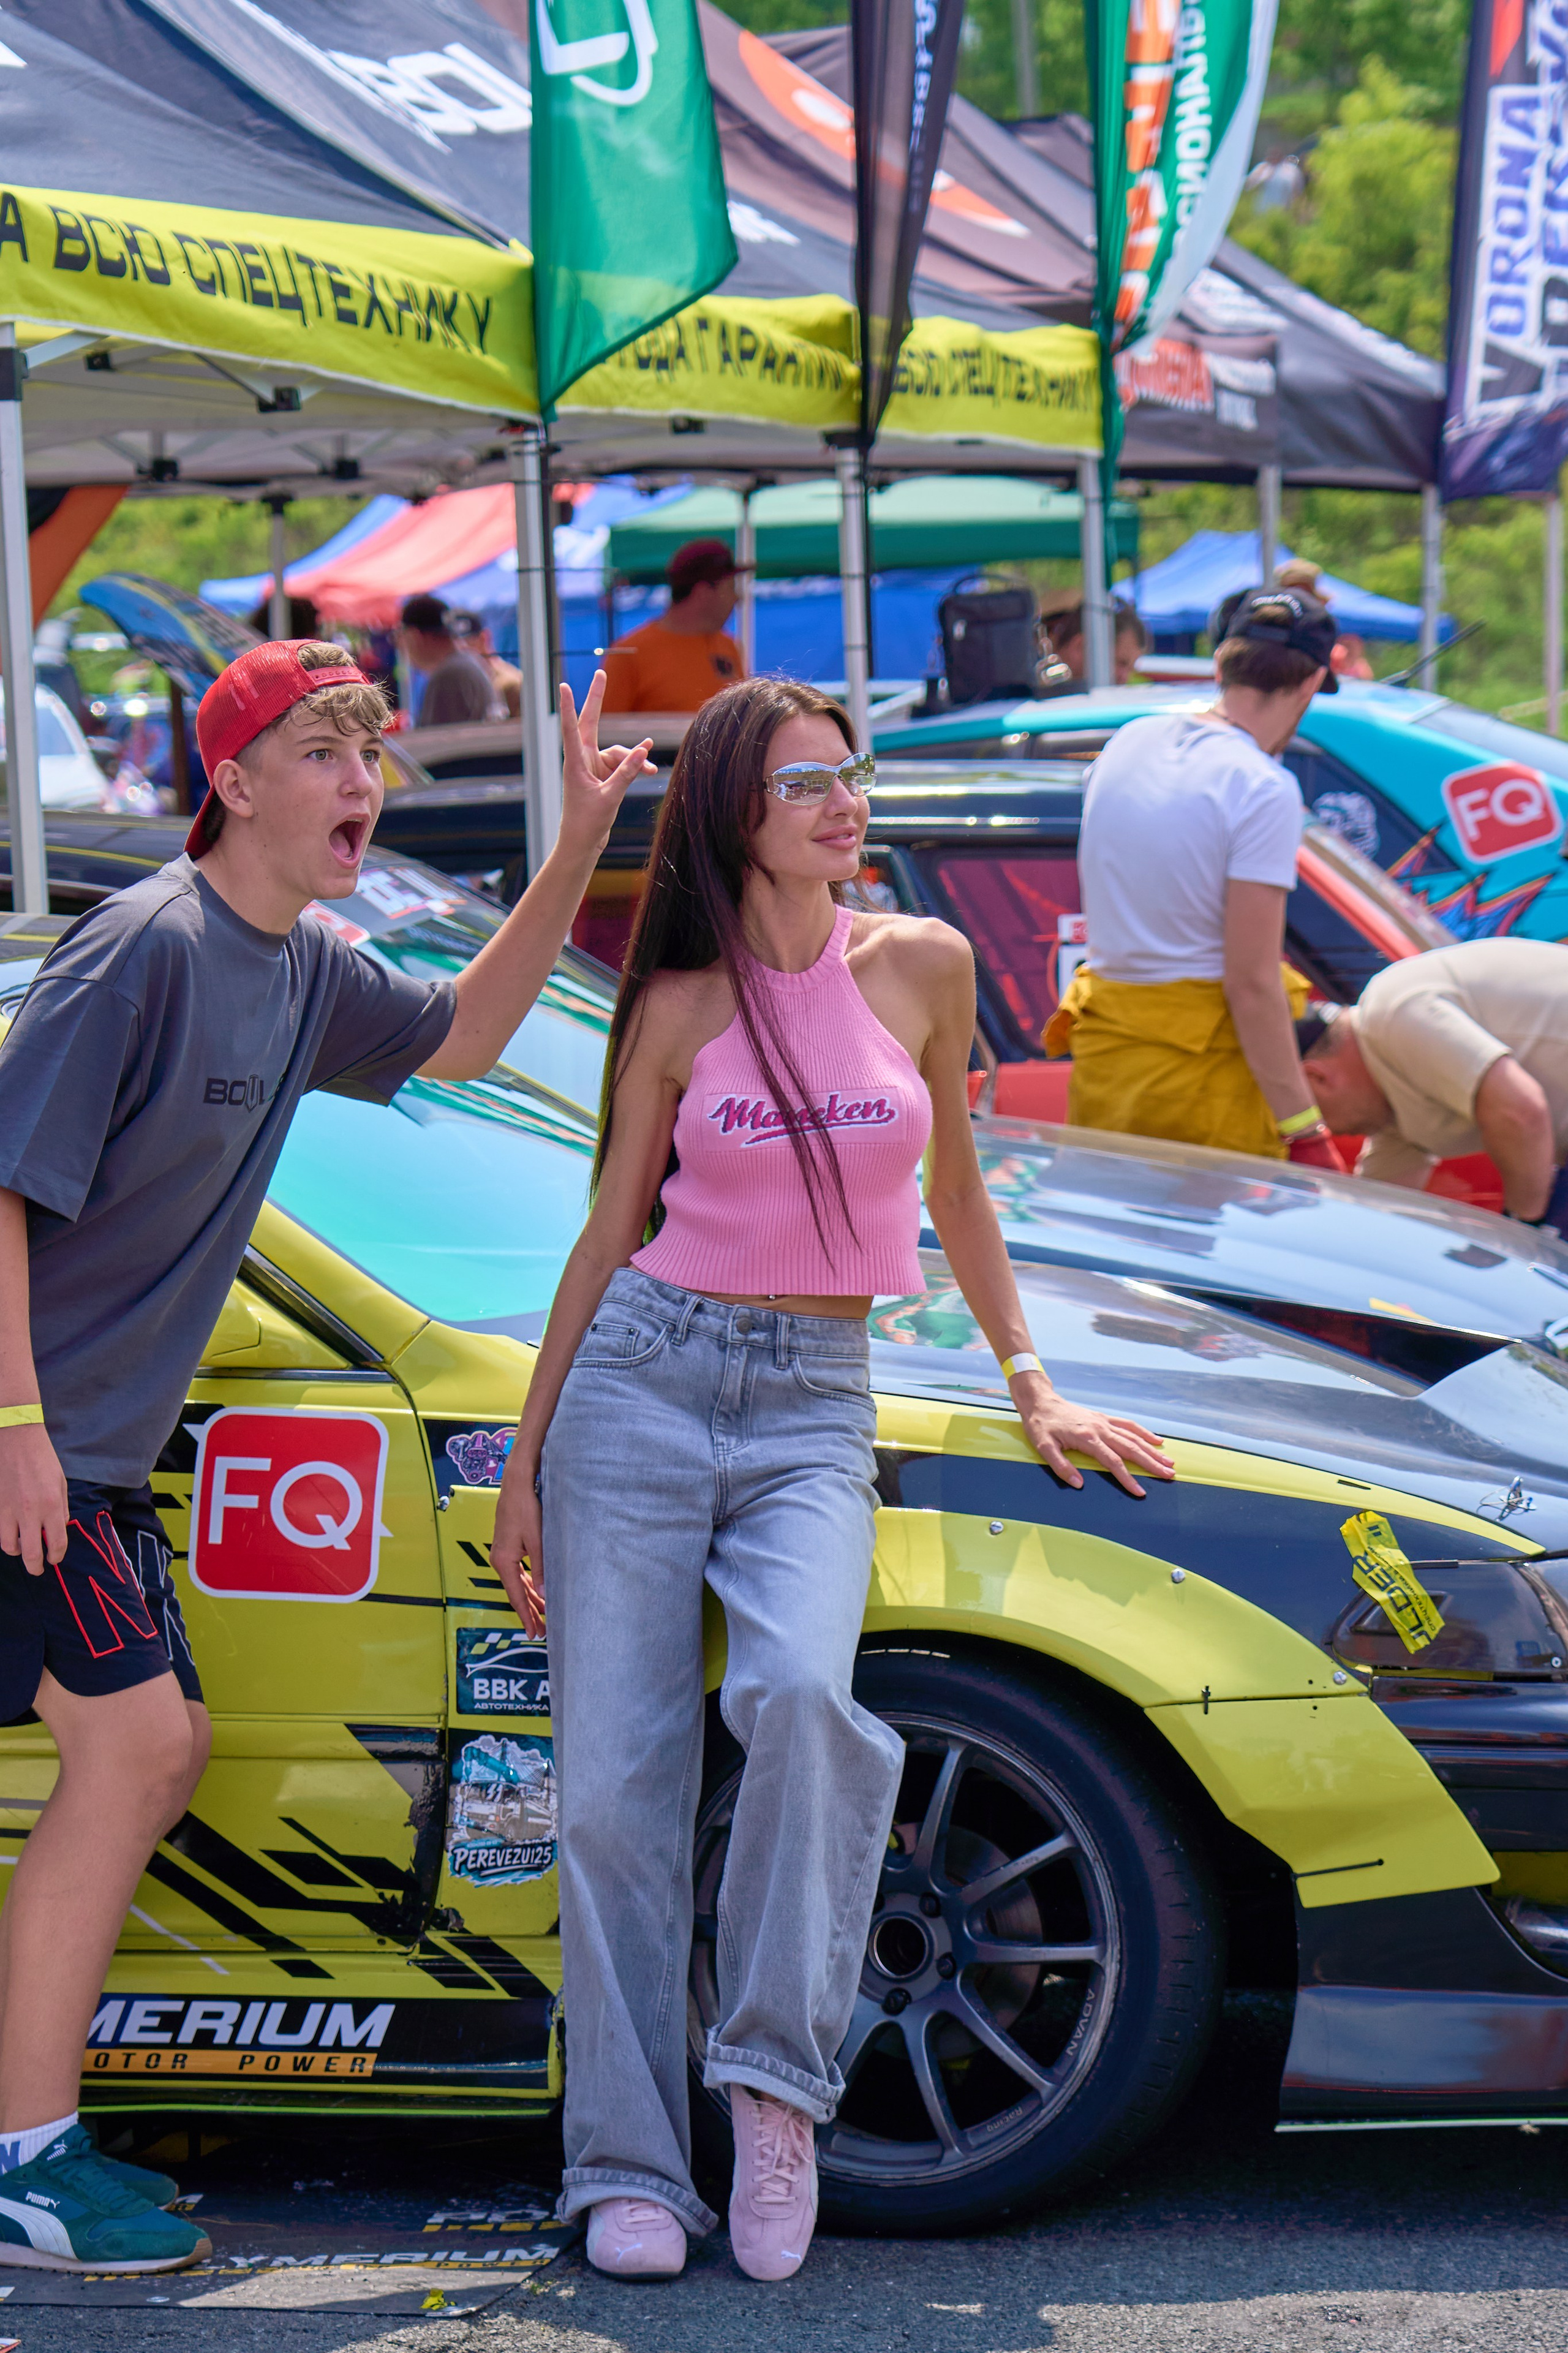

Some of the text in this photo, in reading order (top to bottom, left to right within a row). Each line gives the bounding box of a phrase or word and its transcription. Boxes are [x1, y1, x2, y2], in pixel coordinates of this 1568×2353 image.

[46, 203, 172, 286] ВСЮ
[170, 230, 491, 355] СПЕЦТЕХНИКУ
[1455, 778, 1545, 842] FQ
[208, 1456, 363, 1550] FQ
[474, 1702, 549, 1711] АВТОТЕХНИКА
[453, 1846, 552, 1872] PEREVEZU125
[1066, 1989, 1095, 2056] ADVAN
[238, 2054, 368, 2073] POWER
[986, 2106, 1023, 2132] Racing
[26, 2191, 50, 2207] PUMA
